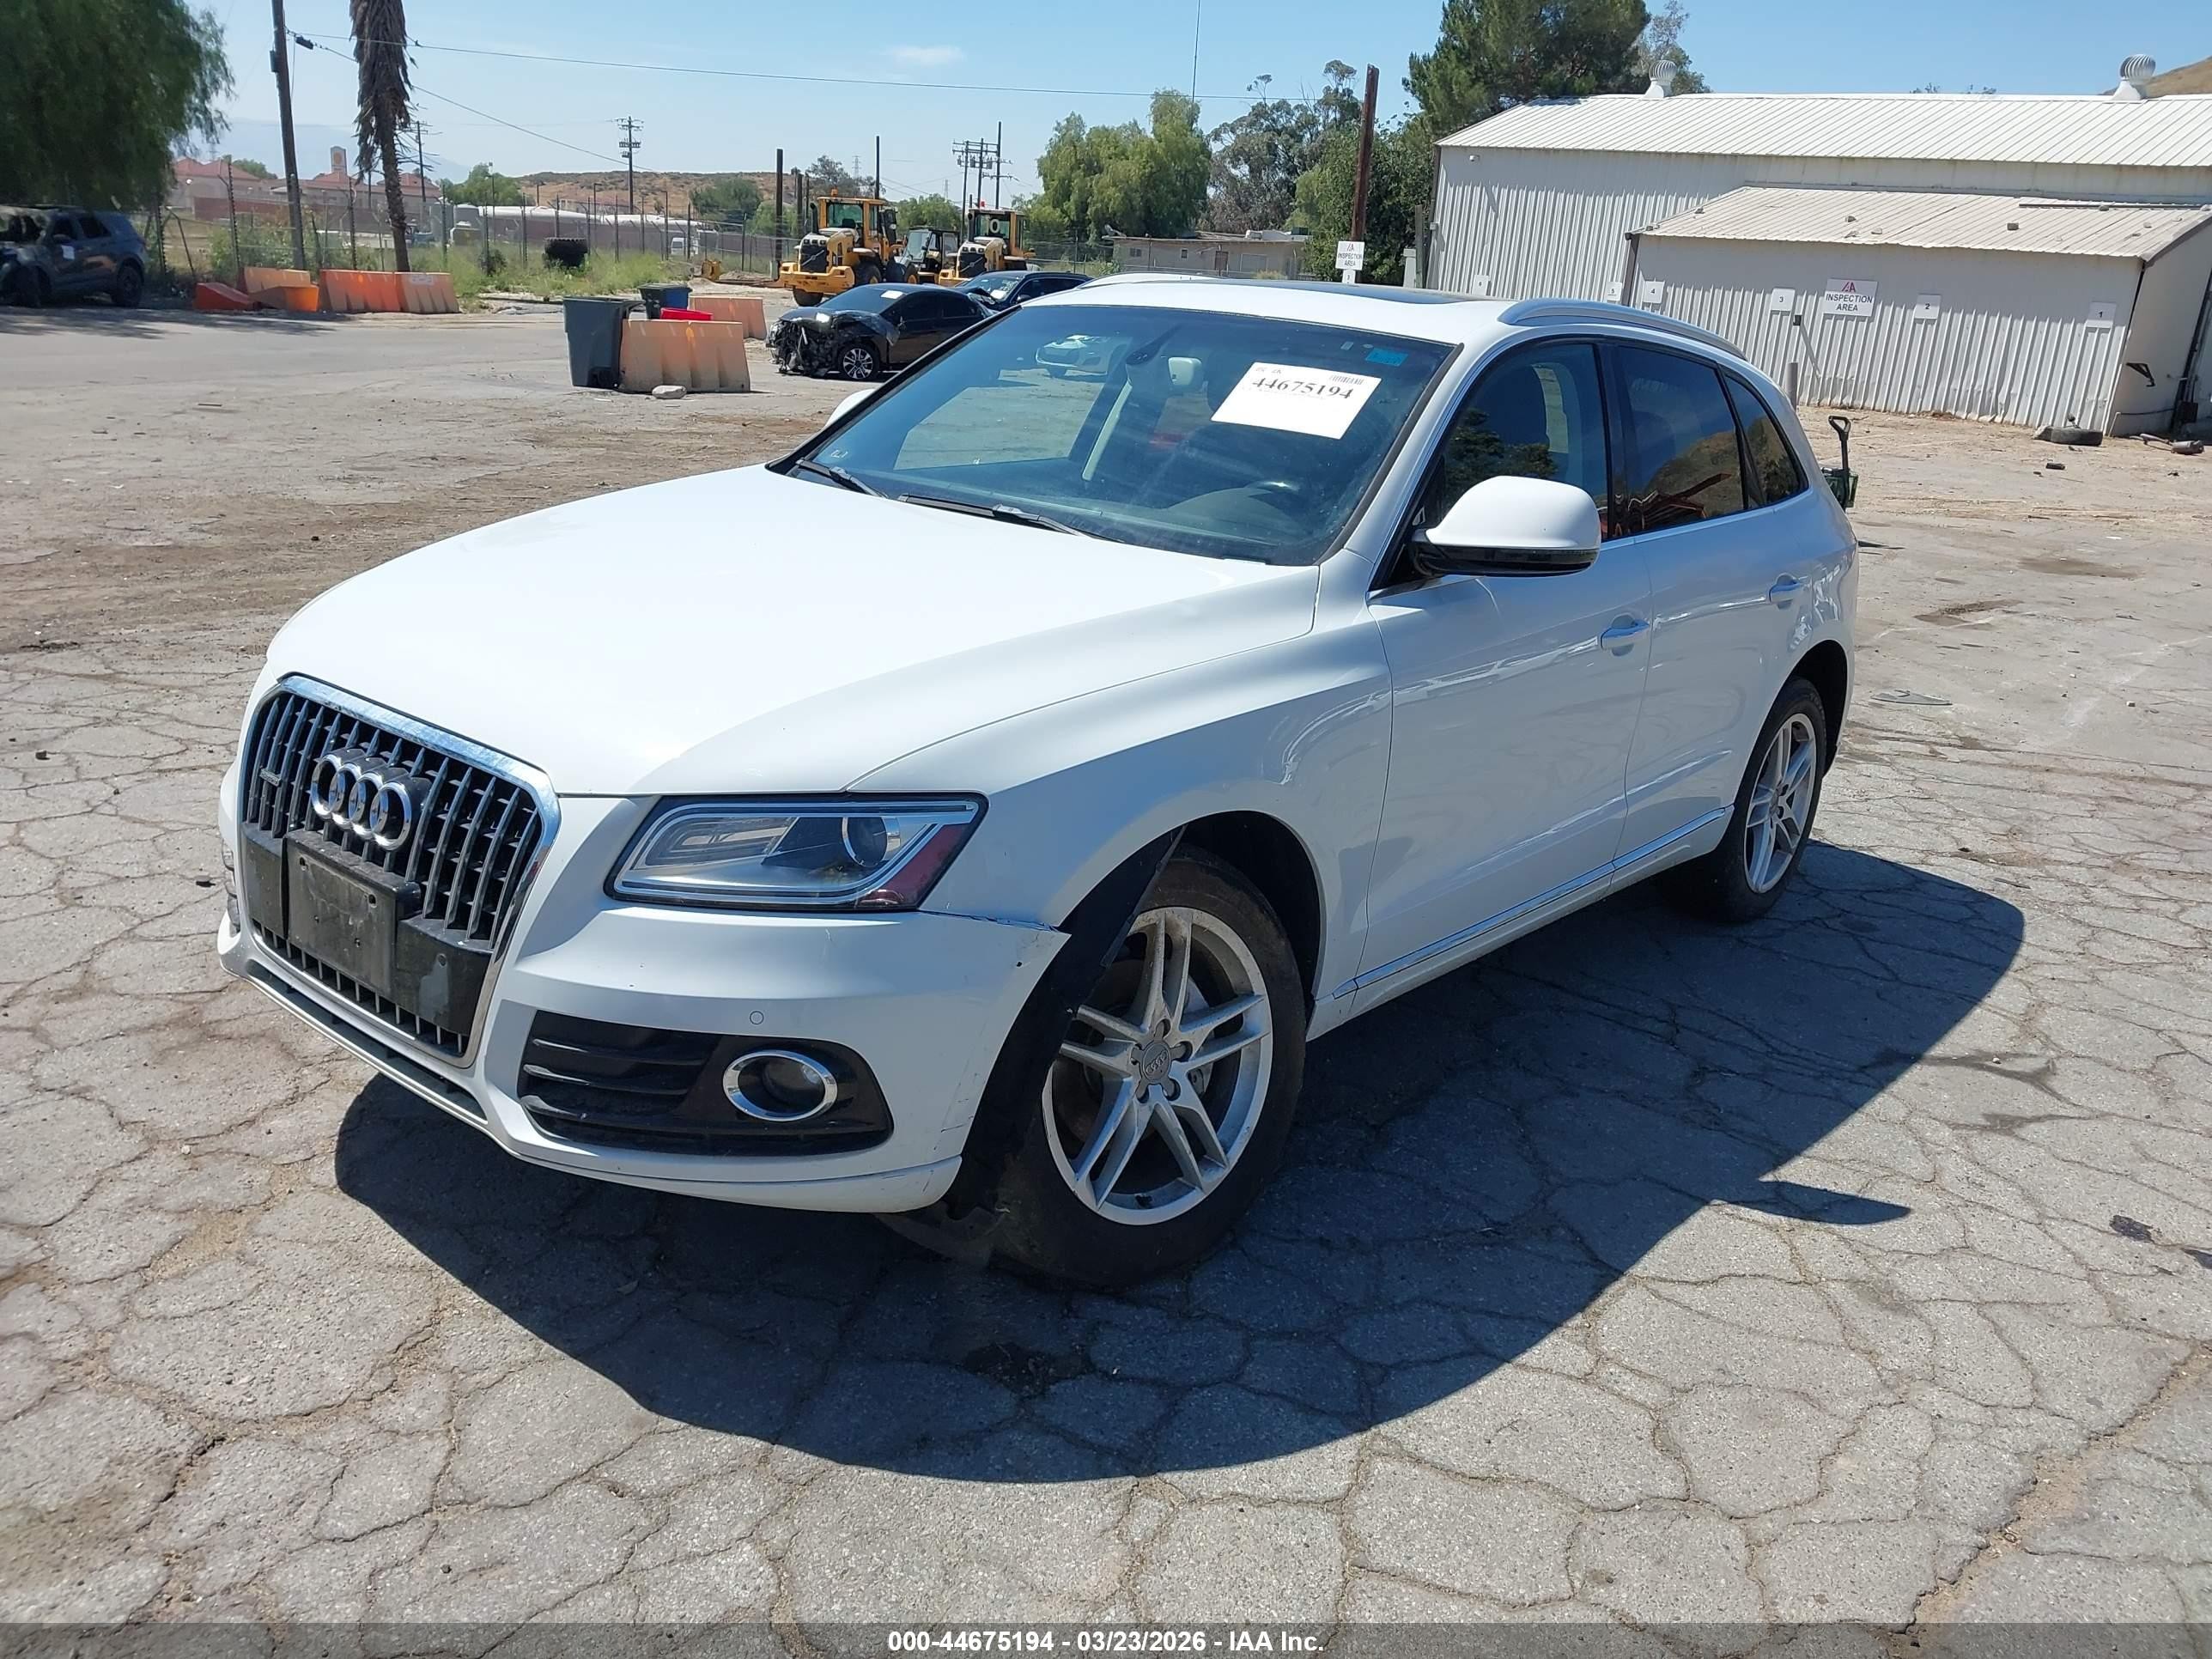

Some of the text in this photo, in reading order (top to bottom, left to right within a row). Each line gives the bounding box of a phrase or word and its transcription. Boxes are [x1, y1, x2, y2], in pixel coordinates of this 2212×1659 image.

[1337, 252, 1363, 260] INSPECTION
[1826, 294, 1873, 303] INSPECTION
[1836, 303, 1858, 312] AREA
[1251, 376, 1355, 399] 44675194
